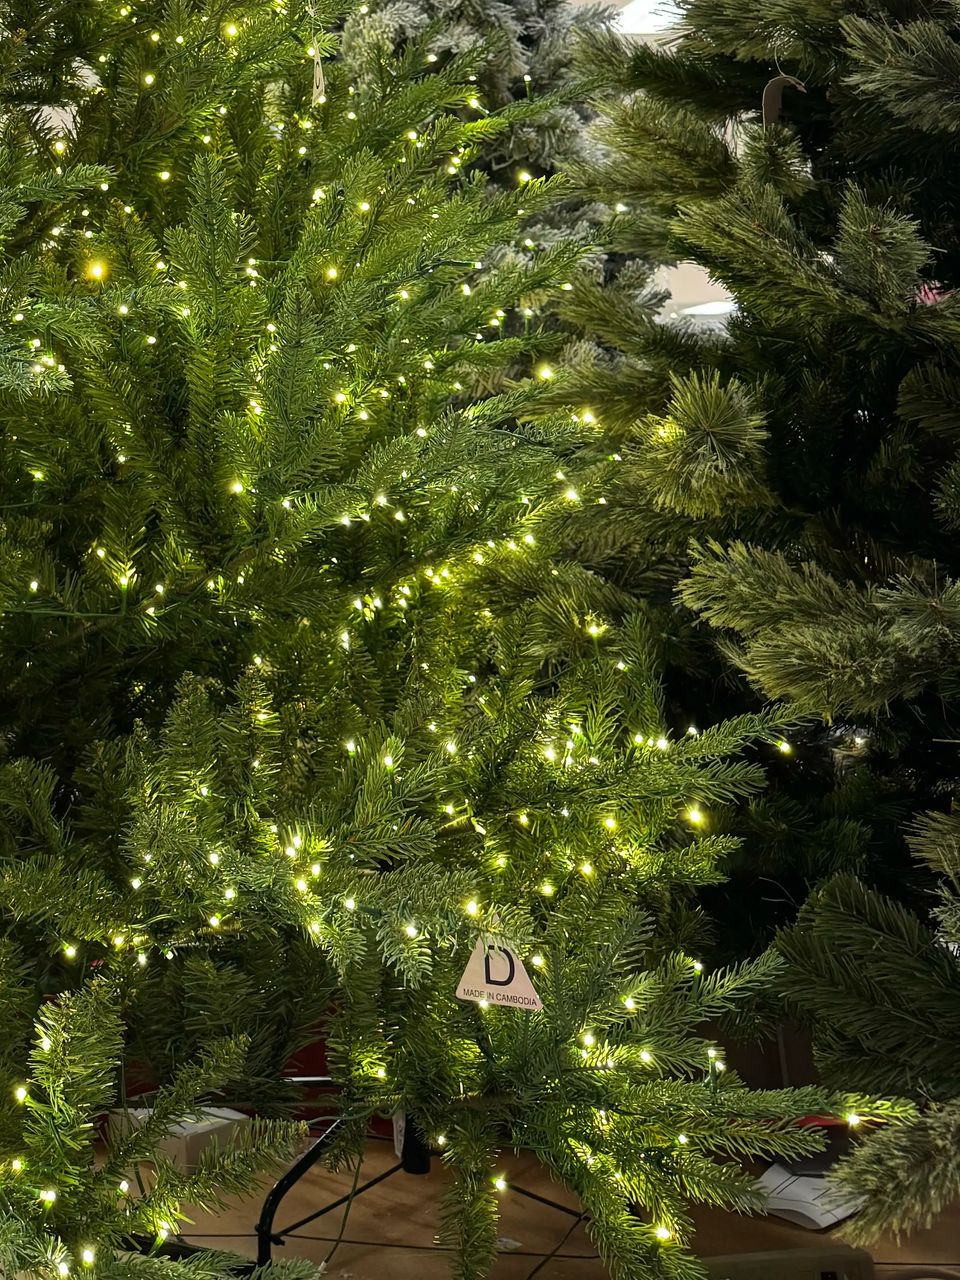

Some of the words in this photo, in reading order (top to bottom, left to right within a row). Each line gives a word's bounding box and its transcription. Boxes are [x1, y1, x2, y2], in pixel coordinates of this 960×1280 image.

[485, 945, 515, 986] D
[463, 988, 485, 998] MADE
[486, 992, 494, 1000] IN
[496, 993, 537, 1006] CAMBODIA
